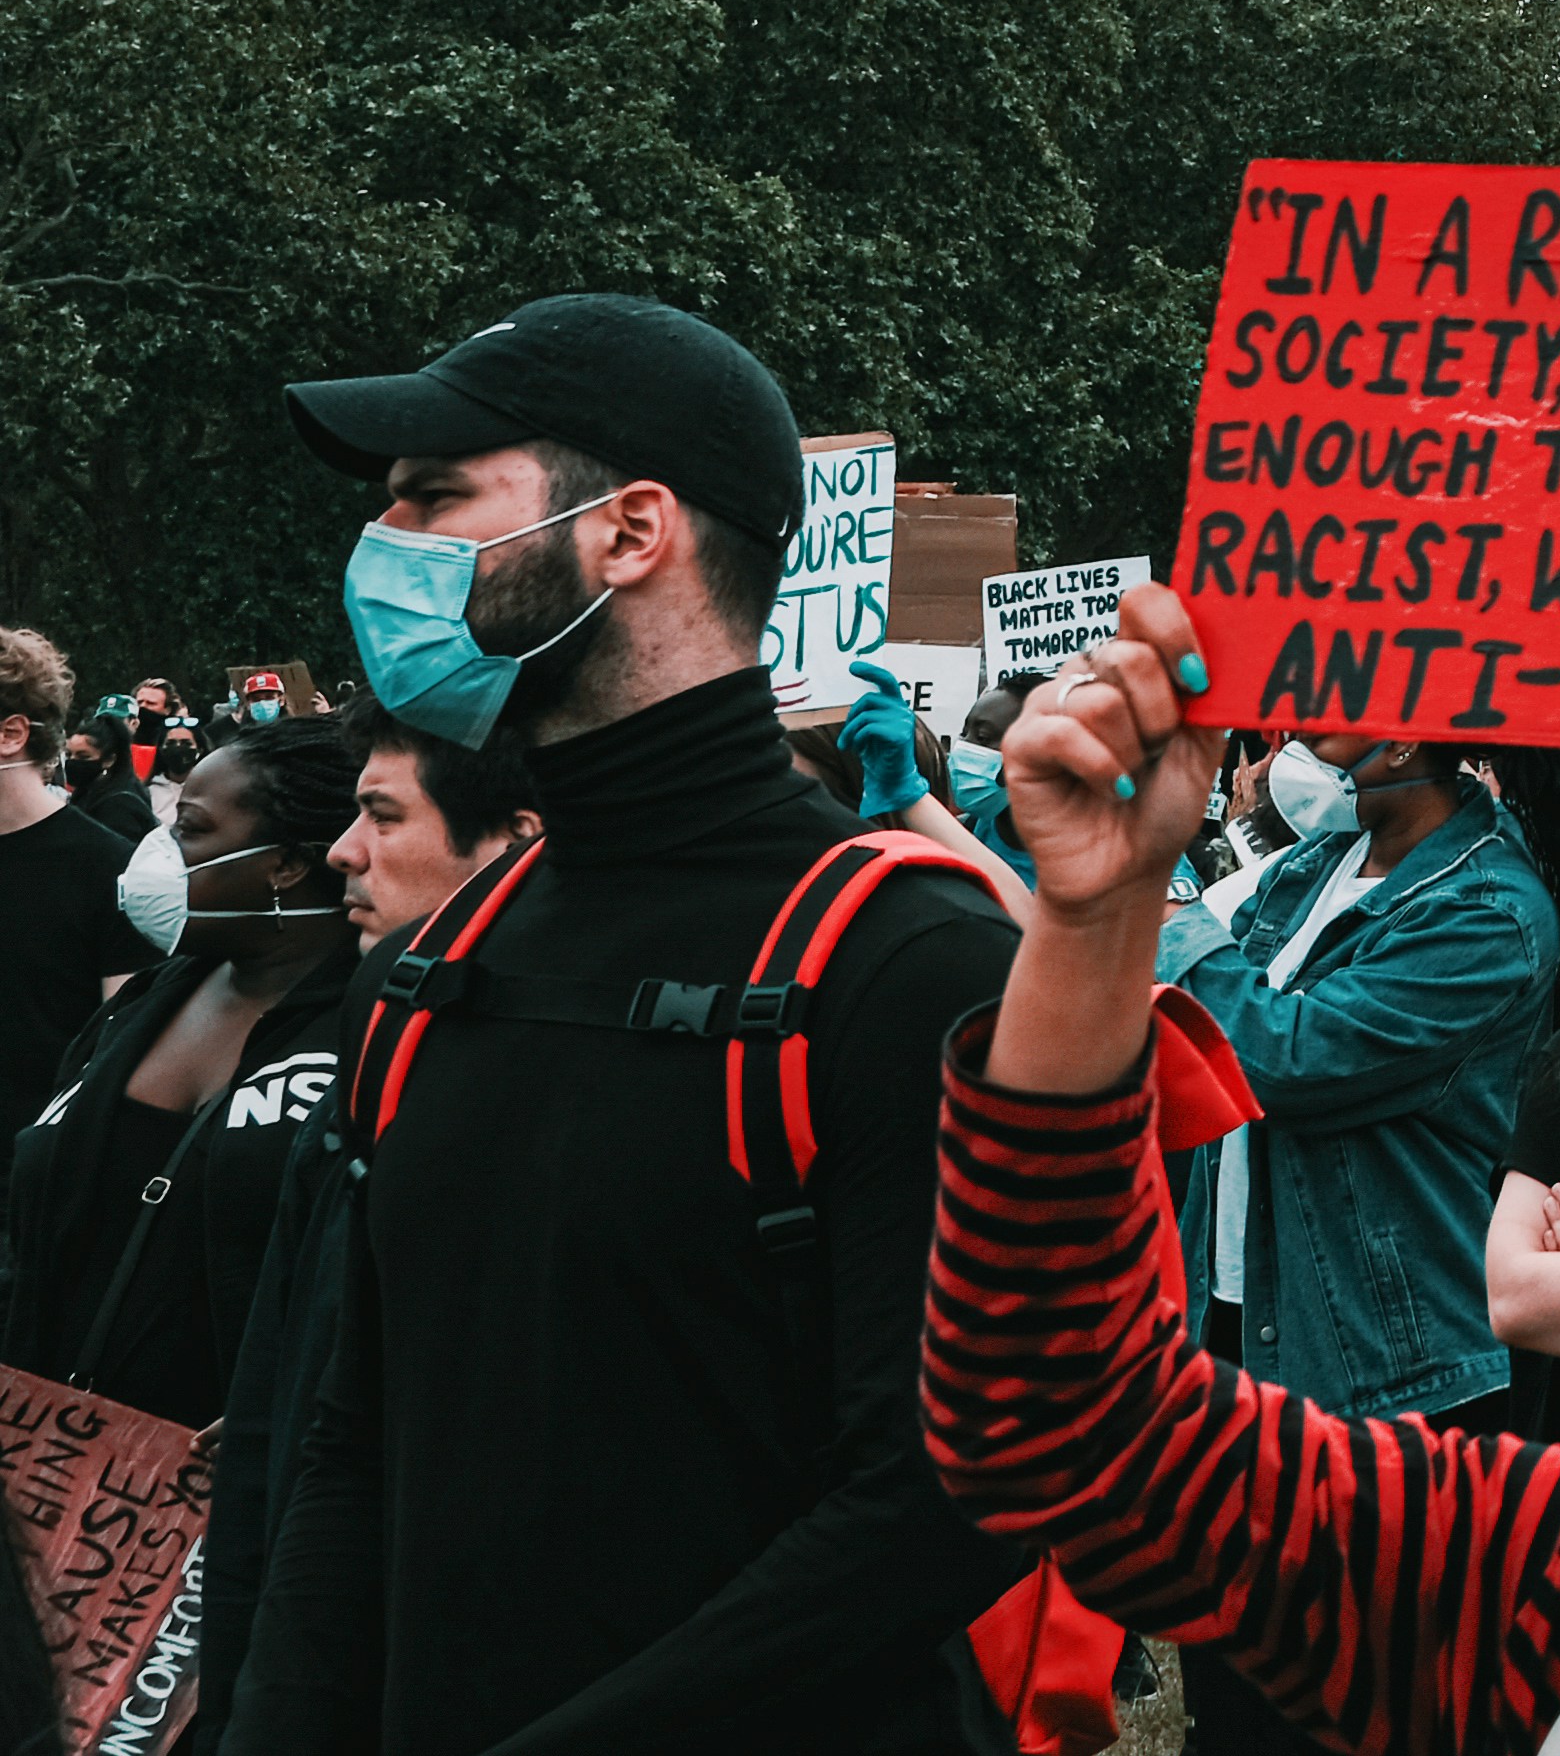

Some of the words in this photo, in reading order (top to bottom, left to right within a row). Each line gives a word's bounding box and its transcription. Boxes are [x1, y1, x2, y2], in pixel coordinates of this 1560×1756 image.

[1416, 196, 1469, 297] A
[810, 446, 894, 507] NOT
[1203, 415, 1496, 497] ENOUGH
[782, 506, 893, 578] OU'RE
[1190, 508, 1505, 614] RACIST,
[836, 581, 886, 658] US
[987, 576, 1048, 608] BLACK
[1056, 566, 1120, 594] LIVES
[999, 599, 1076, 632] MATTER
[71, 1526, 189, 1688] MAKES
